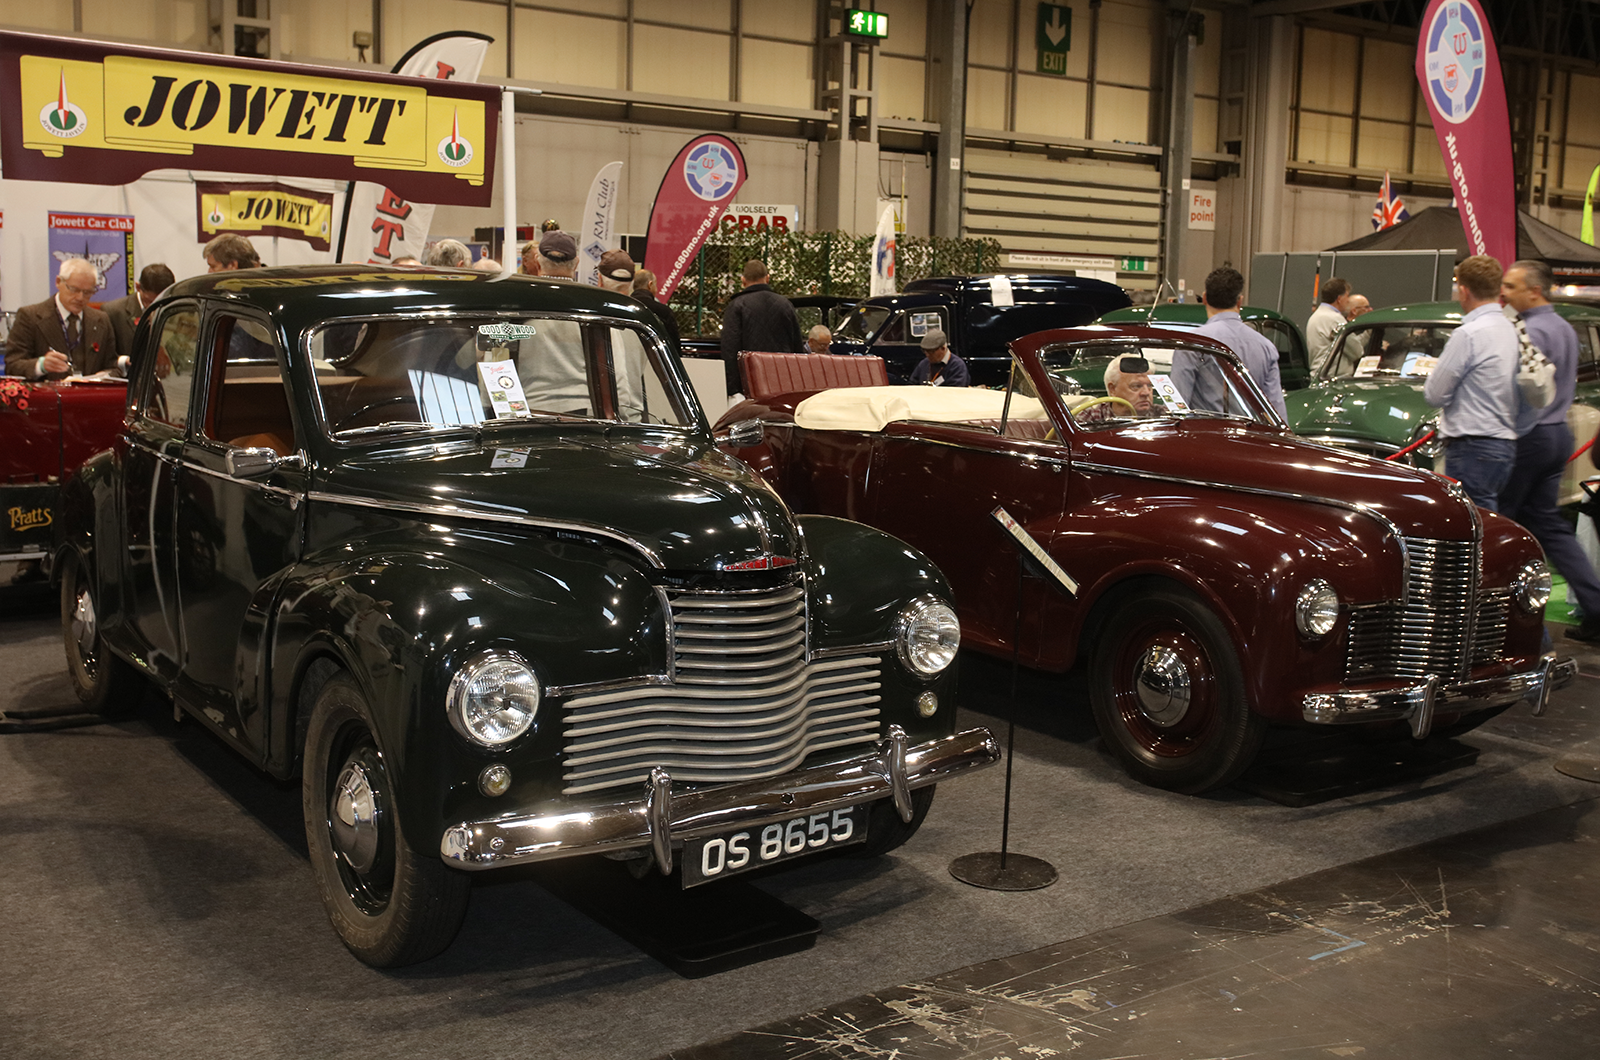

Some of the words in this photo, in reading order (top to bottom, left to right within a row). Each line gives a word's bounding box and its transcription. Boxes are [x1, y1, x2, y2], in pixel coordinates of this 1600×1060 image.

[1043, 51, 1065, 72] EXIT
[123, 75, 408, 146] JOWETT
[41, 119, 64, 137] JOWETT
[597, 178, 609, 209] Club
[1194, 195, 1212, 207] Fire
[238, 197, 314, 226] JOWETT
[736, 205, 778, 214] WOLSELEY
[1190, 211, 1214, 223] point
[50, 216, 85, 229] Jowett
[87, 218, 107, 228] Car
[108, 219, 133, 230] Club
[593, 211, 605, 240] RM
[126, 233, 134, 253] THE
[658, 204, 720, 297] www.680mo.org.uk
[8, 506, 52, 531] Pratts
[702, 832, 750, 876] OS
[760, 806, 854, 860] 8655
